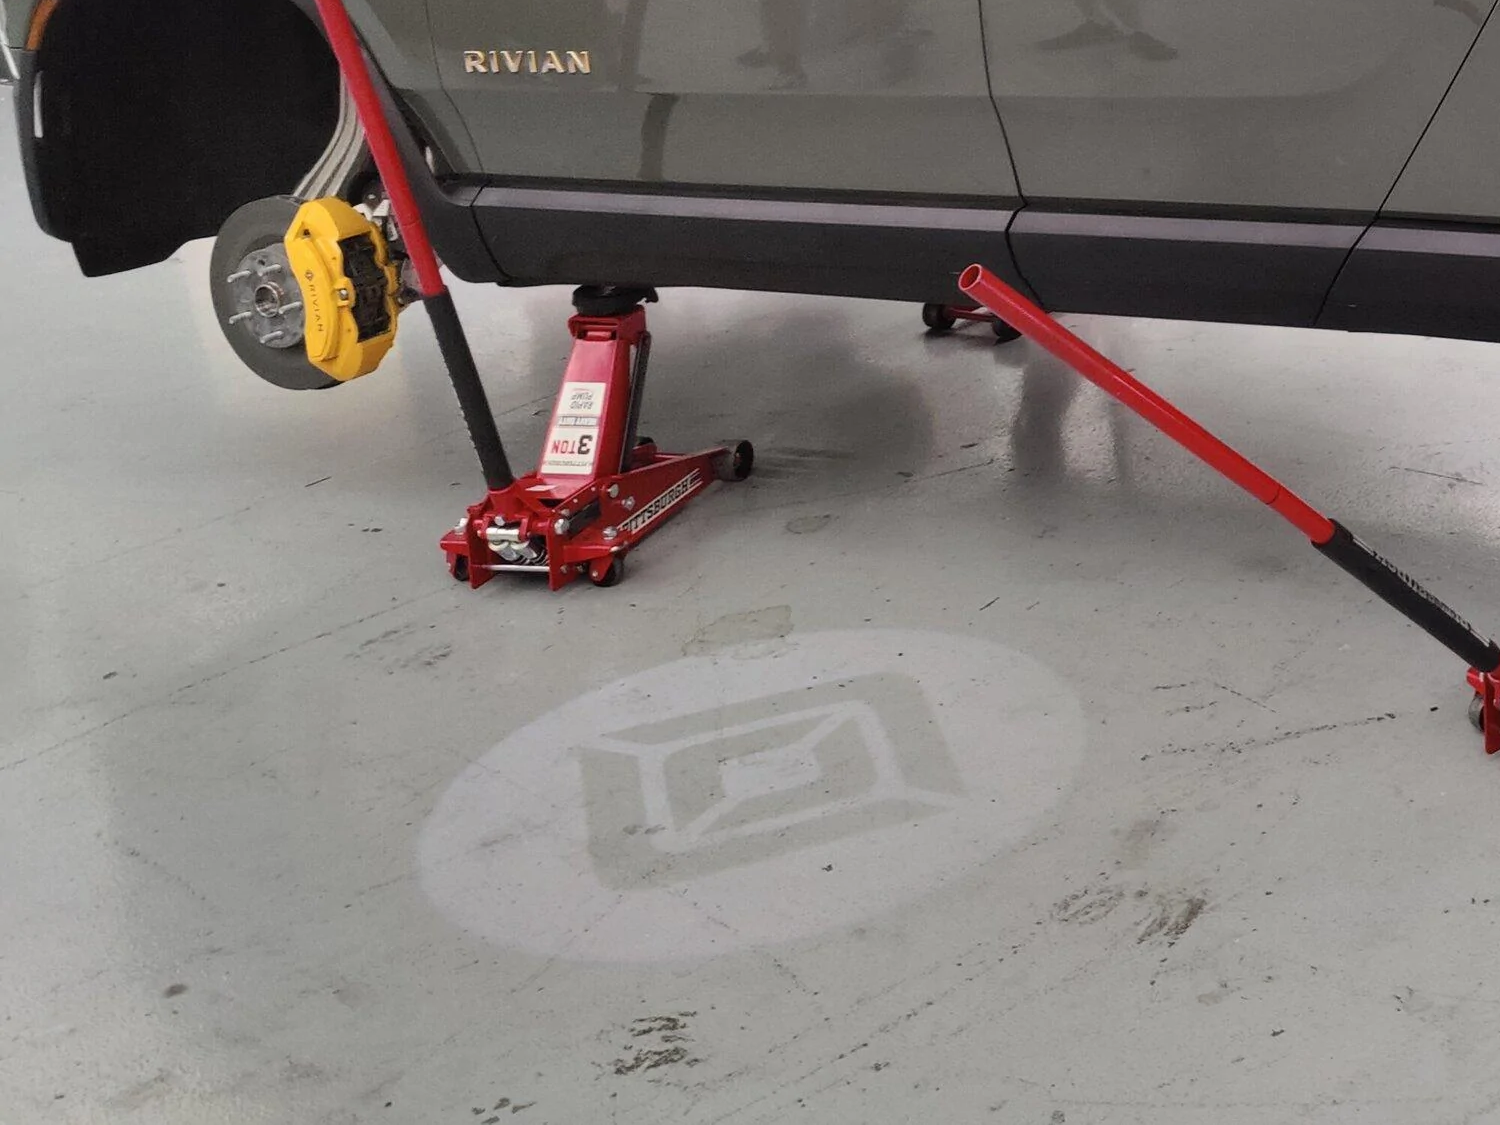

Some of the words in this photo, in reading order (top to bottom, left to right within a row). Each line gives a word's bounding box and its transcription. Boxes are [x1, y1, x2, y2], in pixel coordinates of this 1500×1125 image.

[463, 50, 592, 74] RIVIAN
[308, 284, 325, 333] RIVIAN
[550, 439, 576, 455] TON
[577, 434, 593, 455] 3
